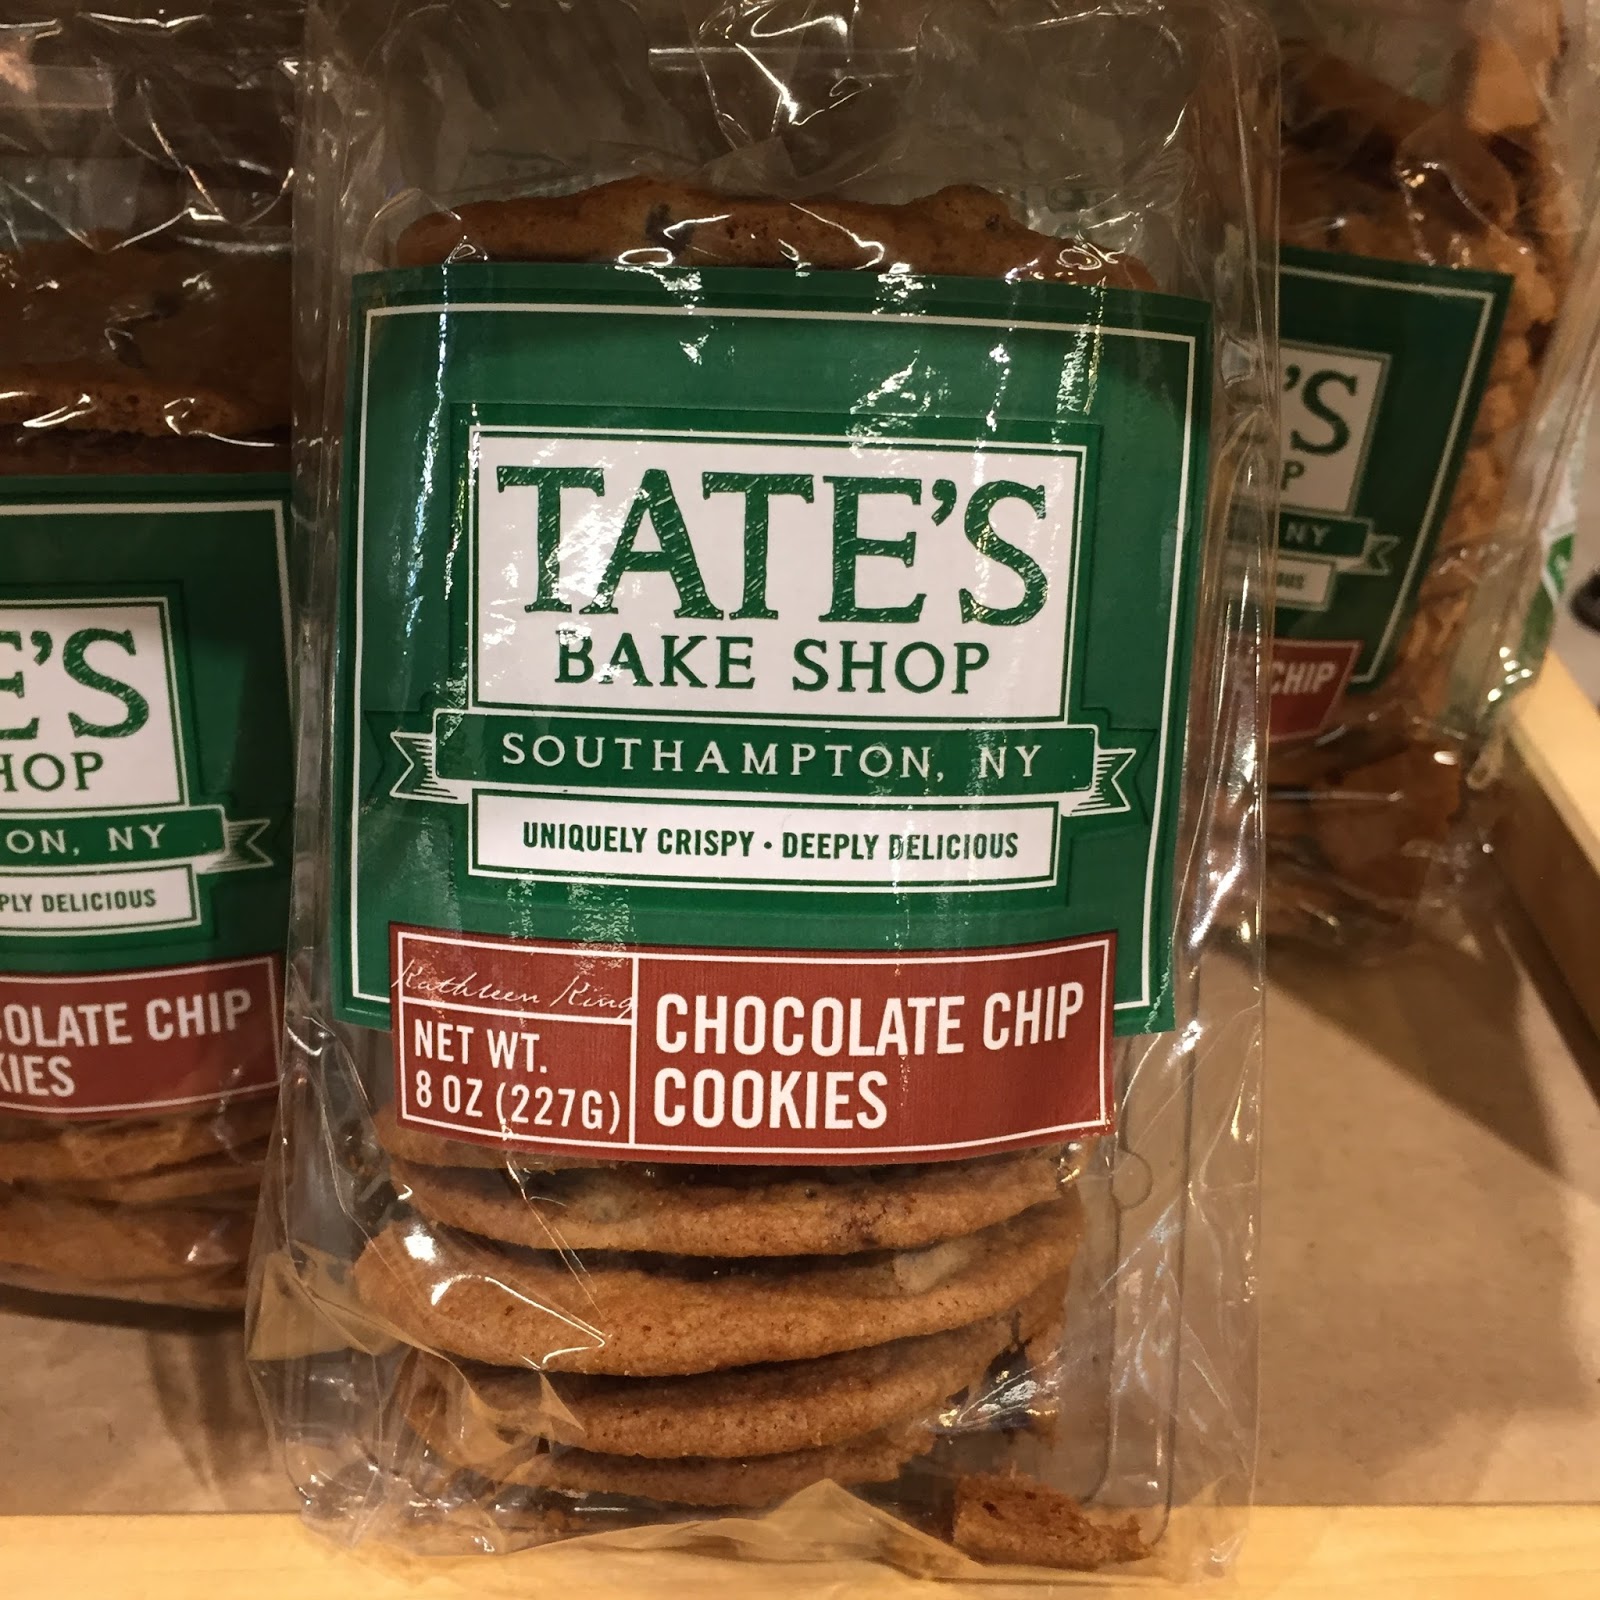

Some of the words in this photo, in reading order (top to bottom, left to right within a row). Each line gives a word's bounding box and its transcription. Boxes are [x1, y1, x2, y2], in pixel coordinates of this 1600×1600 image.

[496, 465, 1049, 626] TATE'S
[554, 628, 757, 690] BAKE
[792, 639, 992, 695] SHOP
[501, 733, 946, 783] SOUTHAMPTON,
[980, 743, 1043, 780] NY
[5, 828, 80, 857] ON,
[107, 823, 168, 852] NY
[522, 821, 647, 855] UNIQUELY
[657, 830, 753, 858] CRISPY
[782, 832, 878, 861] DEEPLY
[889, 832, 1019, 862] DELICIOUS
[41, 888, 156, 913] DELICIOUS
[0, 1001, 134, 1048] OLATE
[145, 987, 252, 1042] CHIP
[413, 1018, 474, 1063] NET
[486, 1028, 548, 1074] WT.
[655, 994, 965, 1057] CHOCOLATE
[981, 981, 1085, 1052] CHIP
[415, 1068, 432, 1107] 8
[441, 1074, 484, 1118] OZ
[496, 1082, 621, 1135] (227G)
[653, 1067, 889, 1130] COOKIES
